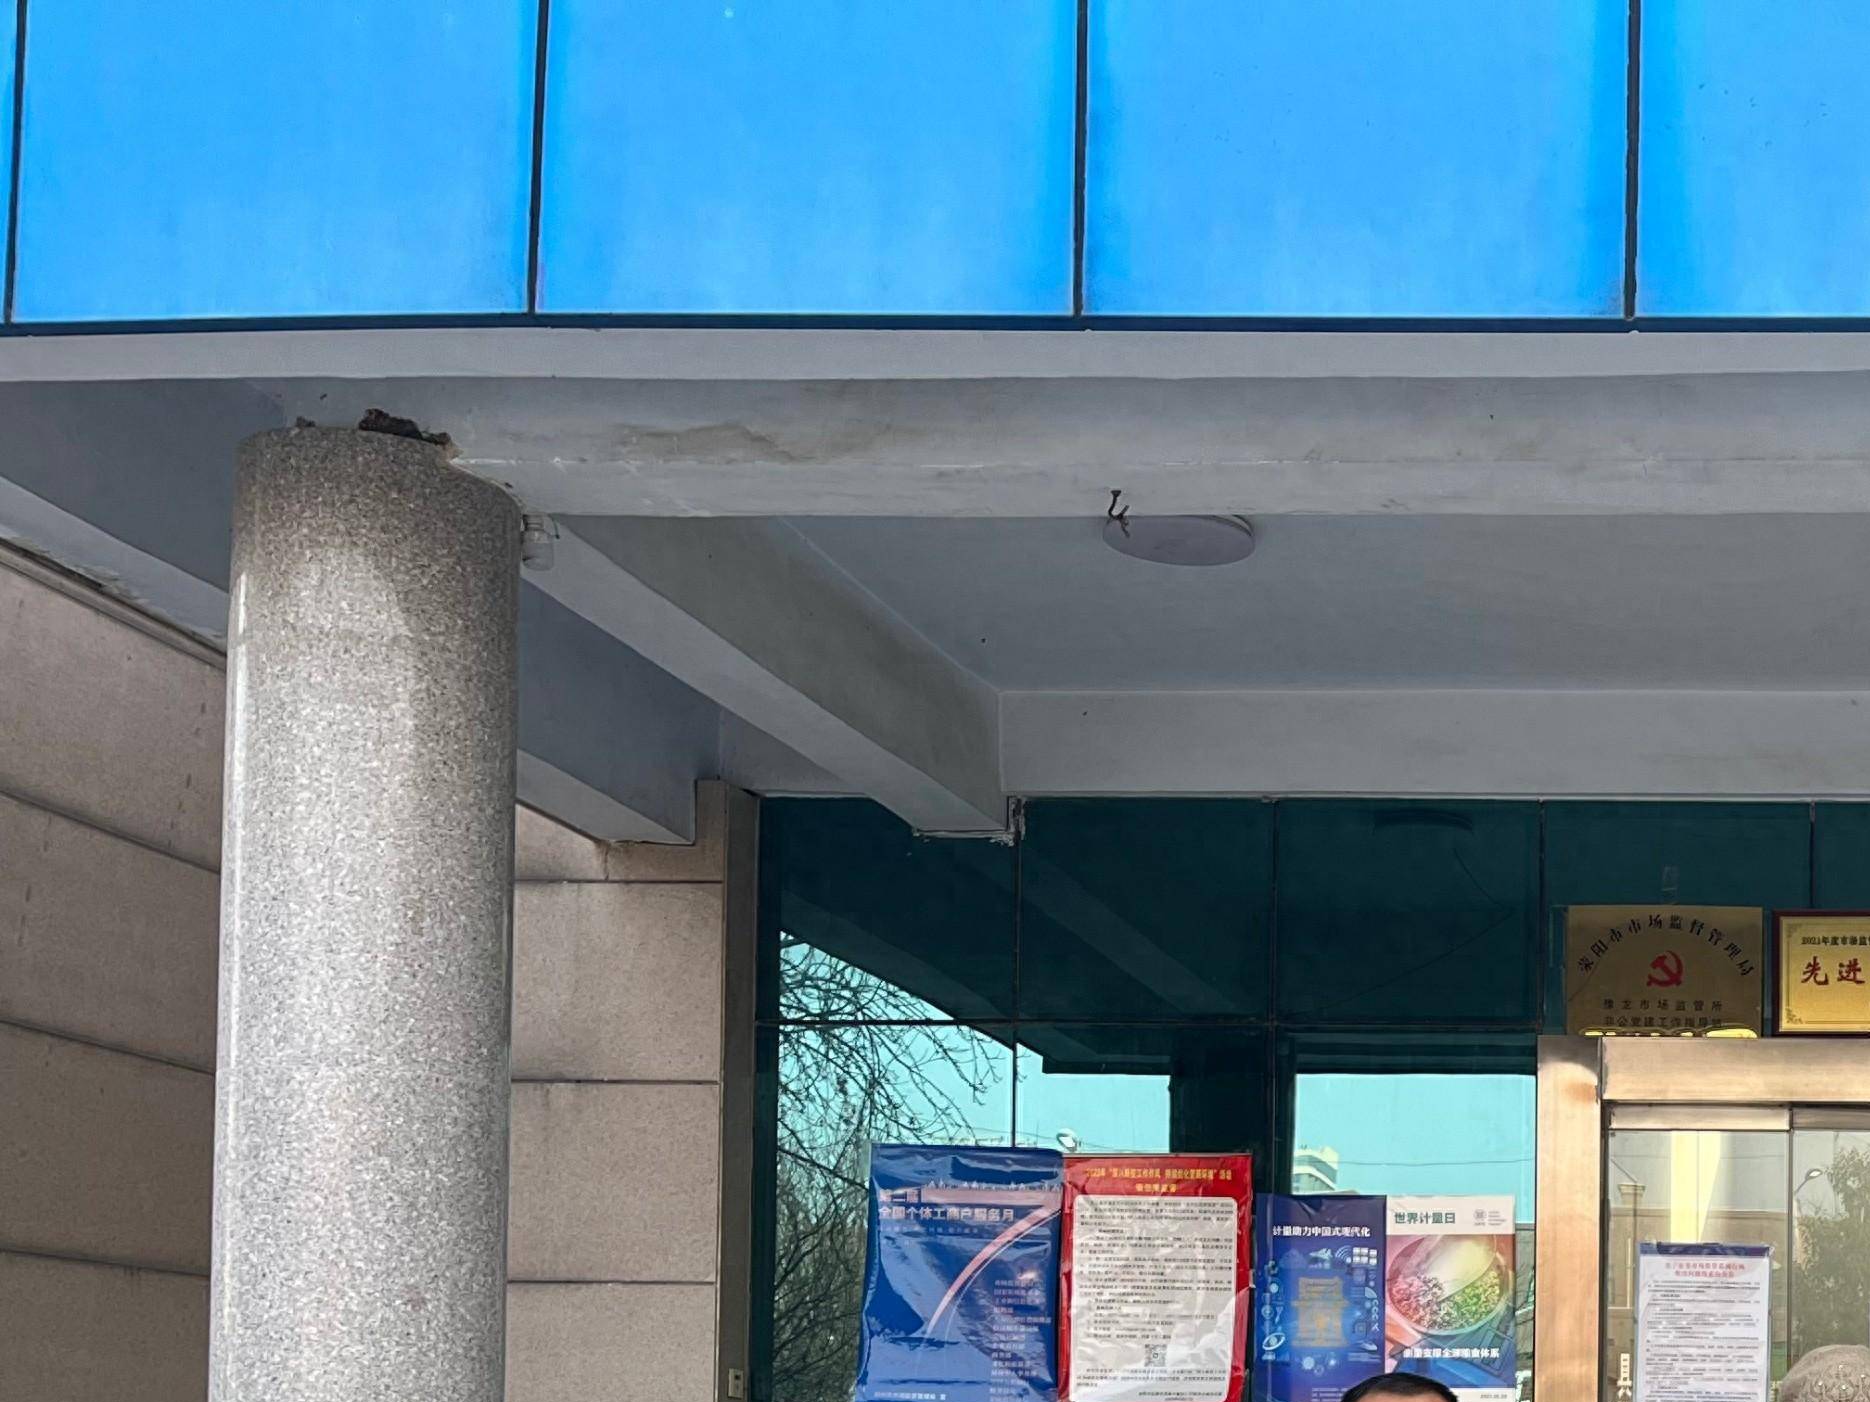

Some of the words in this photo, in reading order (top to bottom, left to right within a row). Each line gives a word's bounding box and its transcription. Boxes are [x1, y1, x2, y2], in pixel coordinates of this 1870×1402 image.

[878, 1205, 1015, 1222] 全国个体工商户服务月
[1394, 1211, 1456, 1225] 世界计量日
[1272, 1225, 1371, 1238] 计量助力中国式现代化
